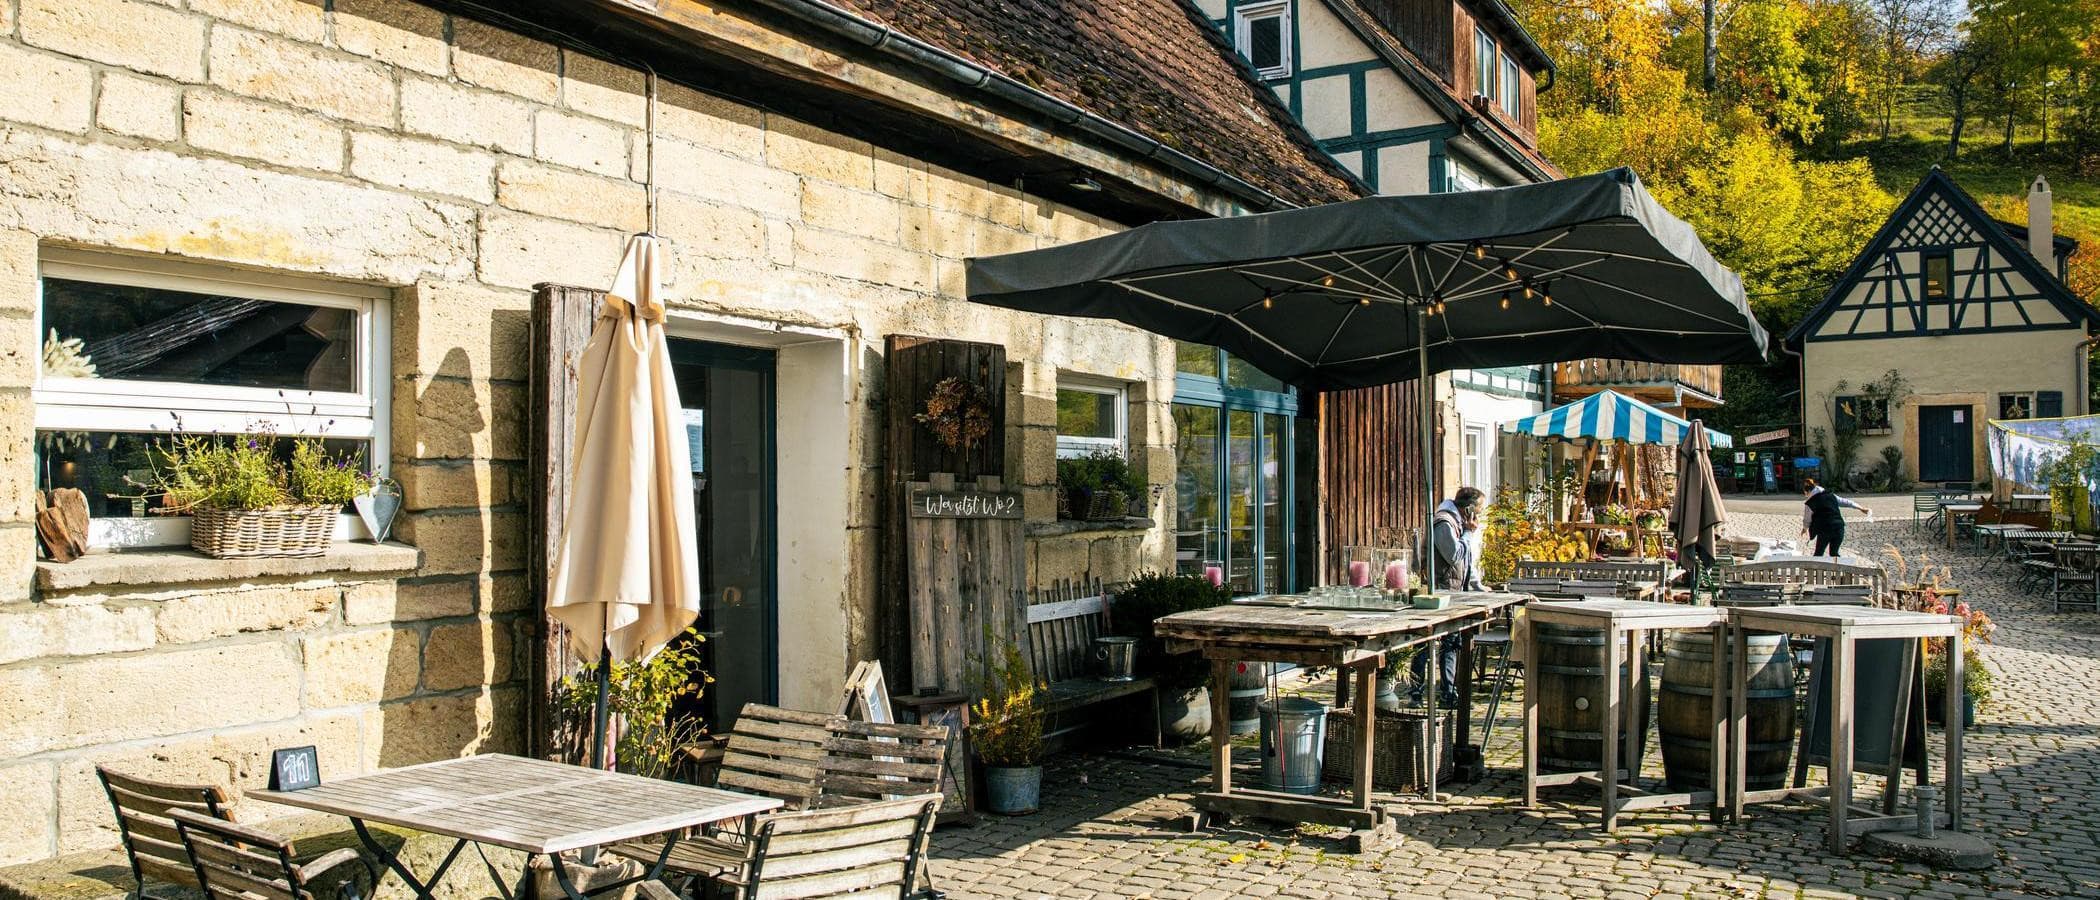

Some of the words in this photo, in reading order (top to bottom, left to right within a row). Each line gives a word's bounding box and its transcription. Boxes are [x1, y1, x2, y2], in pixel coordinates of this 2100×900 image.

[926, 494, 954, 515] Wer
[955, 495, 980, 516] sitzt
[283, 752, 310, 784] 11
